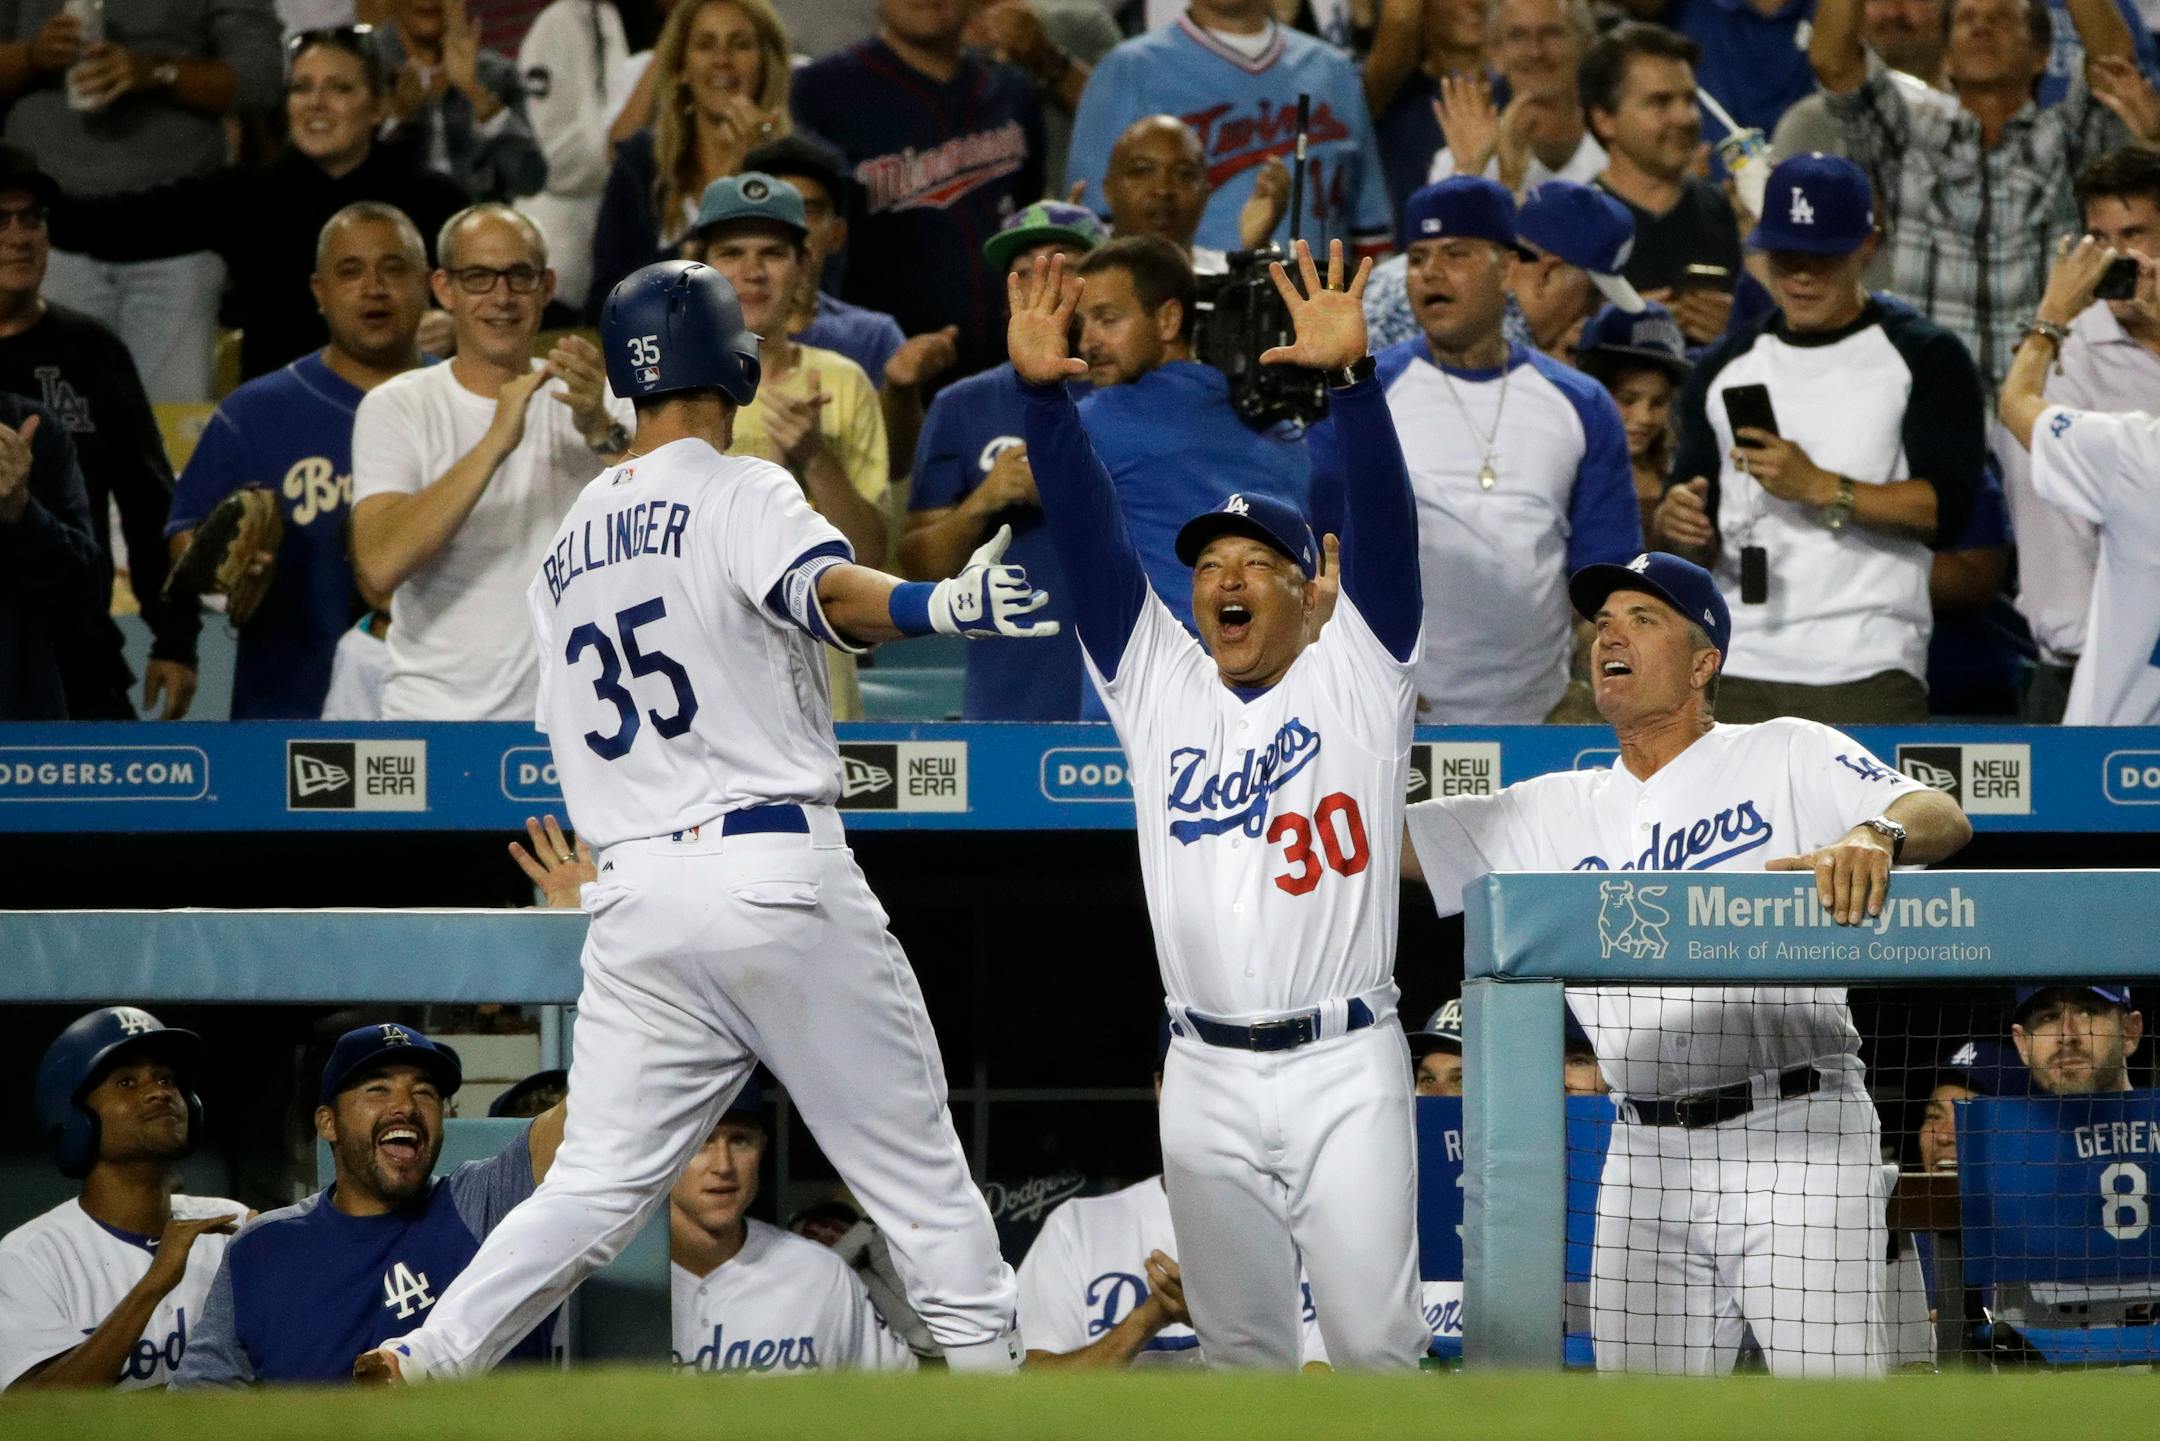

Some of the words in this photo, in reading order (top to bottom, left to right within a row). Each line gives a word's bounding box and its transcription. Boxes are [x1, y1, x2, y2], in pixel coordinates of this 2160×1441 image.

[1789, 187, 1814, 224] LA
[627, 335, 661, 367] 35
[543, 500, 691, 608] BELLINGER
[565, 596, 699, 761] 35
[366, 756, 415, 775] NEW
[908, 758, 956, 776] NEW
[1443, 758, 1489, 777] NEW
[1973, 760, 2020, 778] NEW
[366, 776, 415, 795] ERA
[908, 777, 956, 796] ERA
[1168, 717, 1321, 846] Dodgers
[1443, 778, 1489, 796] ERA
[1973, 780, 2020, 798] ERA
[1266, 791, 1370, 896] 30
[1571, 800, 1773, 870] dgers
[1850, 888, 1975, 934] ynch
[1688, 941, 1740, 960] Bank
[1748, 940, 1769, 960] of
[1776, 942, 1861, 960] America
[1869, 942, 1991, 965] Corporation
[110, 1008, 153, 1036] LA
[379, 1023, 411, 1046] LA
[2100, 1162, 2149, 1240] 8
[383, 1262, 435, 1320] LA
